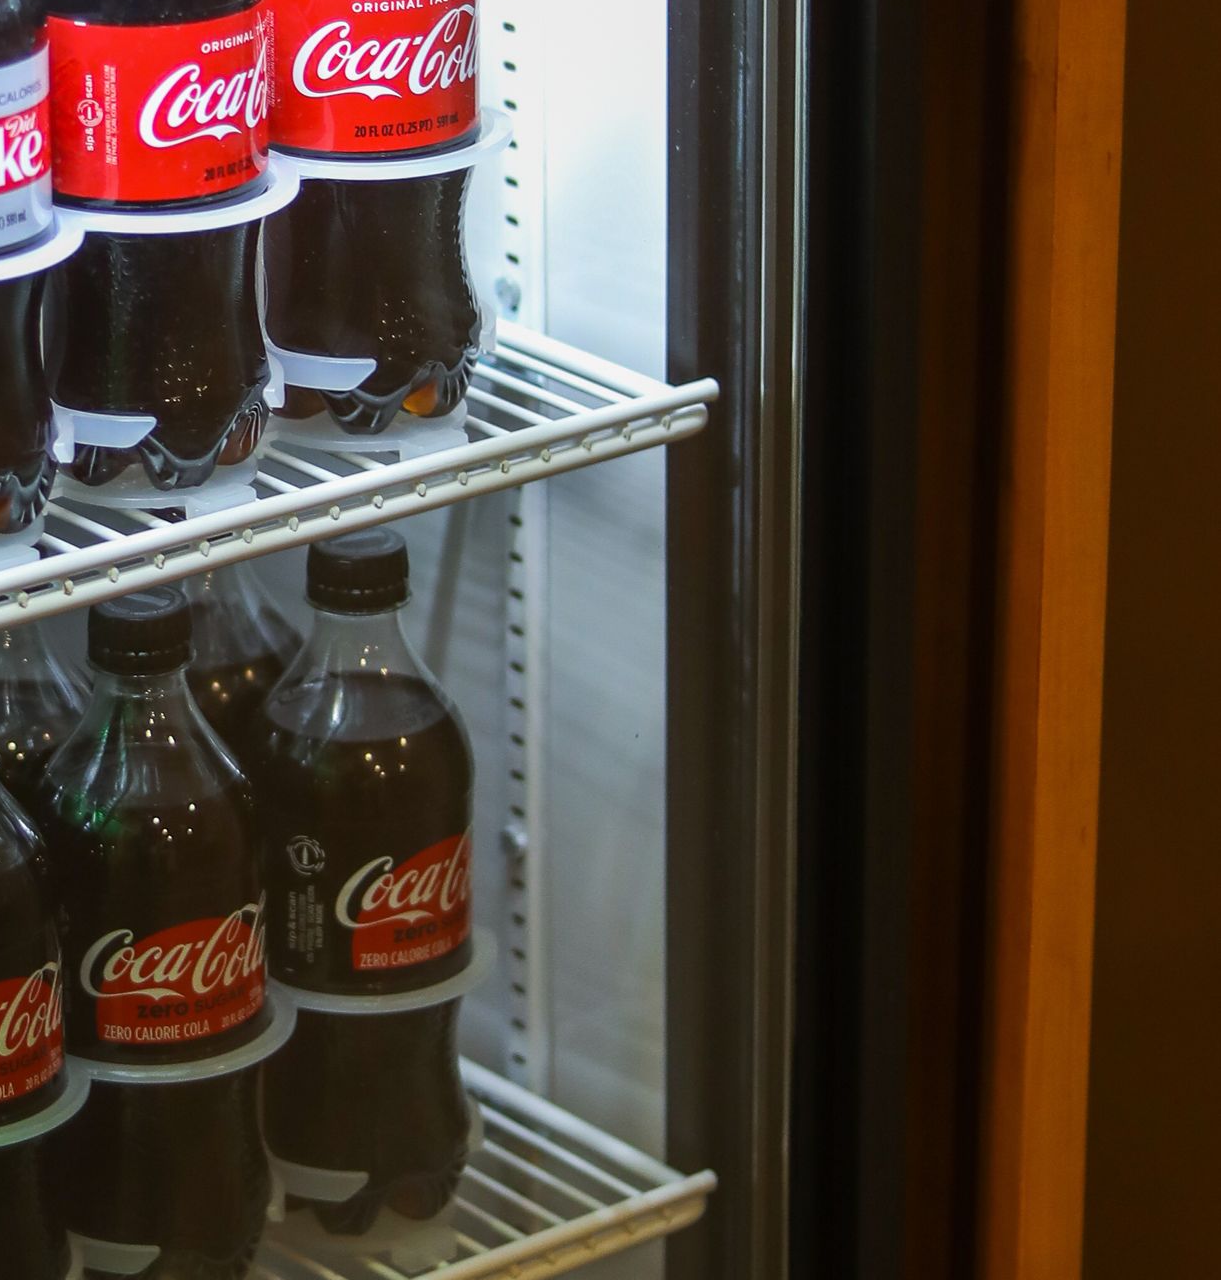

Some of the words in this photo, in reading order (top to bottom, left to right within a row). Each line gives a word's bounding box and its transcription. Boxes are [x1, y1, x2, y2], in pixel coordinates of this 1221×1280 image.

[201, 32, 254, 54] ORIGINAL
[293, 4, 480, 101] Coca-Cola
[85, 75, 93, 98] scan
[4, 111, 38, 139] Diet
[354, 125, 367, 138] 20
[369, 124, 379, 137] FL
[382, 122, 394, 136] OZ
[396, 120, 418, 138] (1.25
[86, 135, 94, 152] sip
[80, 889, 267, 1001] Coca-Cola
[360, 952, 388, 967] ZERO
[392, 945, 430, 965] CALORIE
[104, 1024, 131, 1039] ZERO
[135, 1024, 180, 1041] CALORIE
[184, 1020, 210, 1038] COLA
